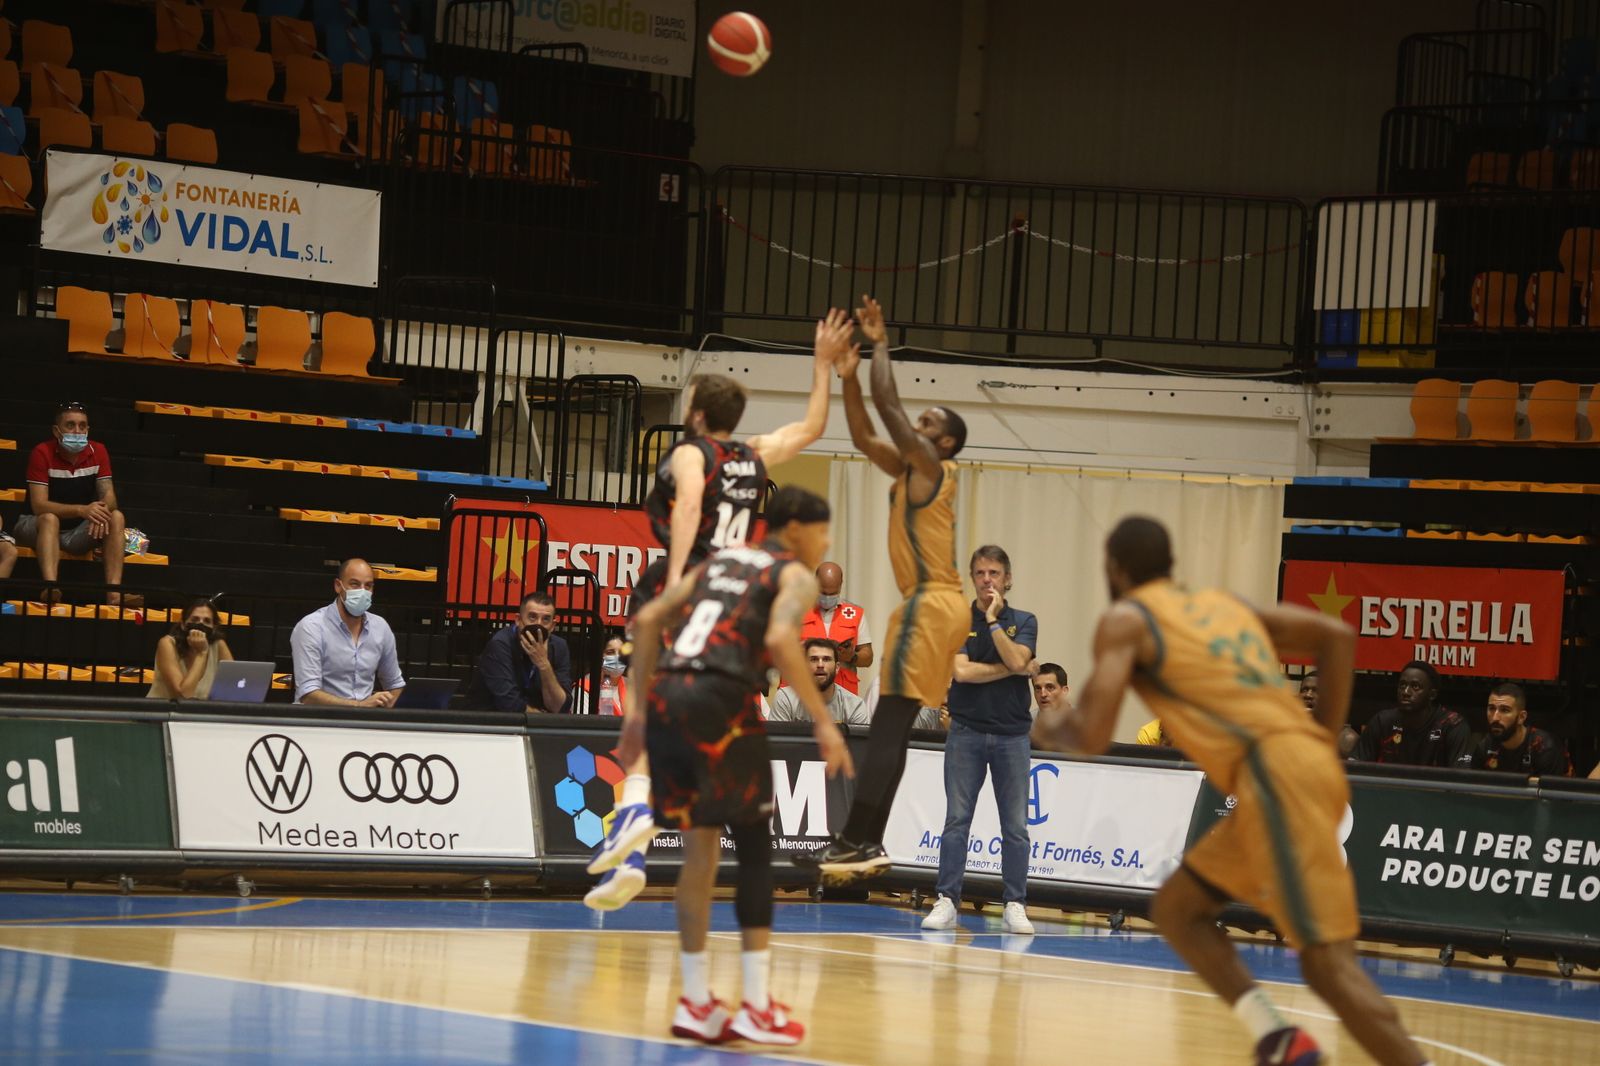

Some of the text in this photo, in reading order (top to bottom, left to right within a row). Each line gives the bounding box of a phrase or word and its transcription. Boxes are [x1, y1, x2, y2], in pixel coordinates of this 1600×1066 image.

[654, 15, 686, 30] DIARIO
[654, 27, 688, 42] DIGITAL
[175, 181, 302, 216] FONTANERÍA
[710, 501, 751, 549] 14
[674, 599, 724, 657] 8
[1360, 596, 1534, 644] ESTRELLA
[1414, 643, 1476, 667] DAMM
[34, 818, 82, 835] mobles
[258, 821, 459, 850] Medea Motor
[1380, 824, 1445, 853] ARA
[1454, 830, 1467, 854] I
[1473, 832, 1533, 860] PER
[918, 830, 983, 854] Anio
[1043, 842, 1105, 868] Fornés,
[1111, 848, 1144, 869] S.A.
[966, 859, 990, 869] CABOT
[1038, 867, 1054, 875] 1910
[1380, 858, 1552, 898] PRODUCTE
